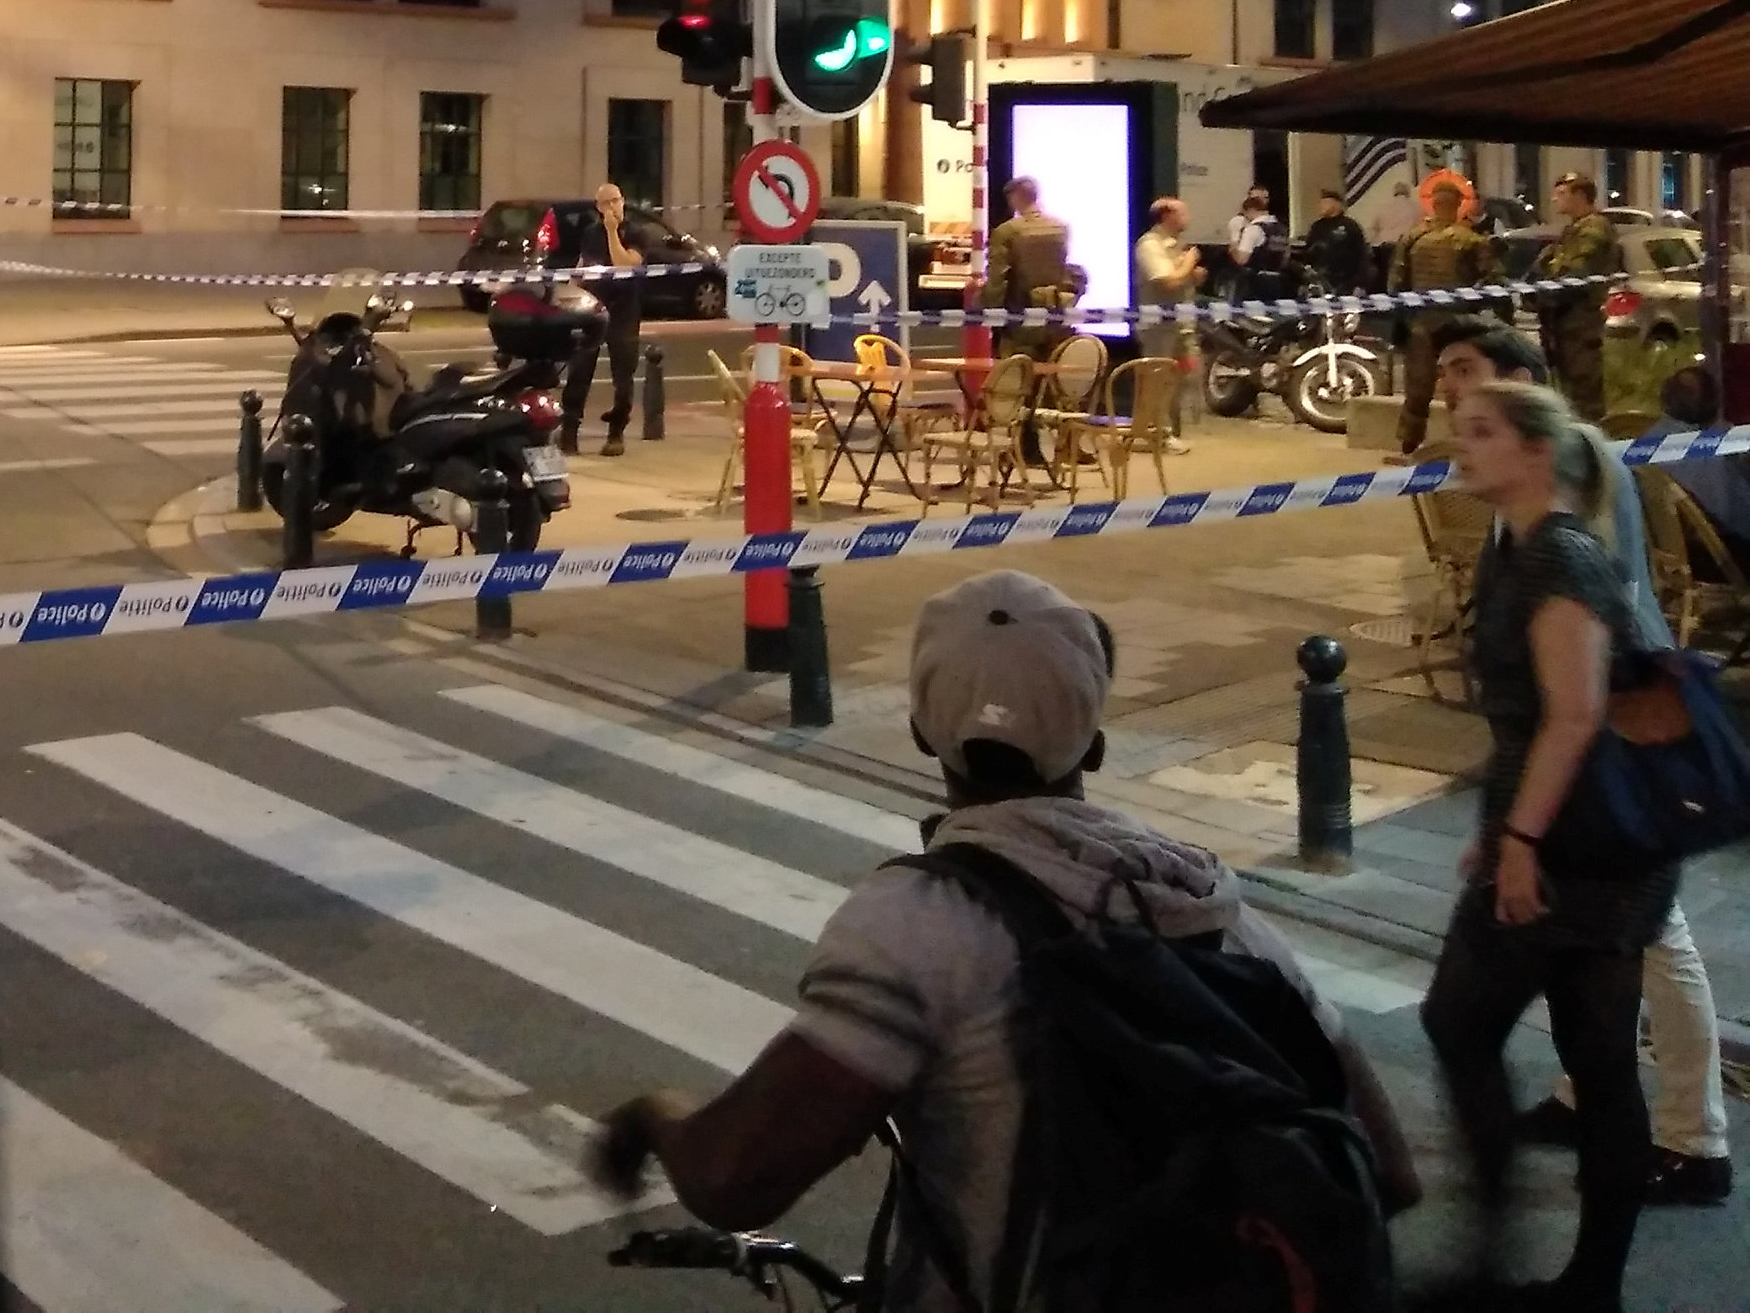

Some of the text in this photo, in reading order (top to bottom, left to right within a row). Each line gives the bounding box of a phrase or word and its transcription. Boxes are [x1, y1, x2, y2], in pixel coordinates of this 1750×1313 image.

[491, 562, 535, 582] Police
[623, 552, 661, 571] Police
[353, 573, 397, 595] Police
[421, 569, 469, 589] Politie
[201, 588, 250, 612] Police
[276, 580, 326, 602] Politie
[38, 602, 89, 624] Police
[119, 596, 172, 617] Politie
